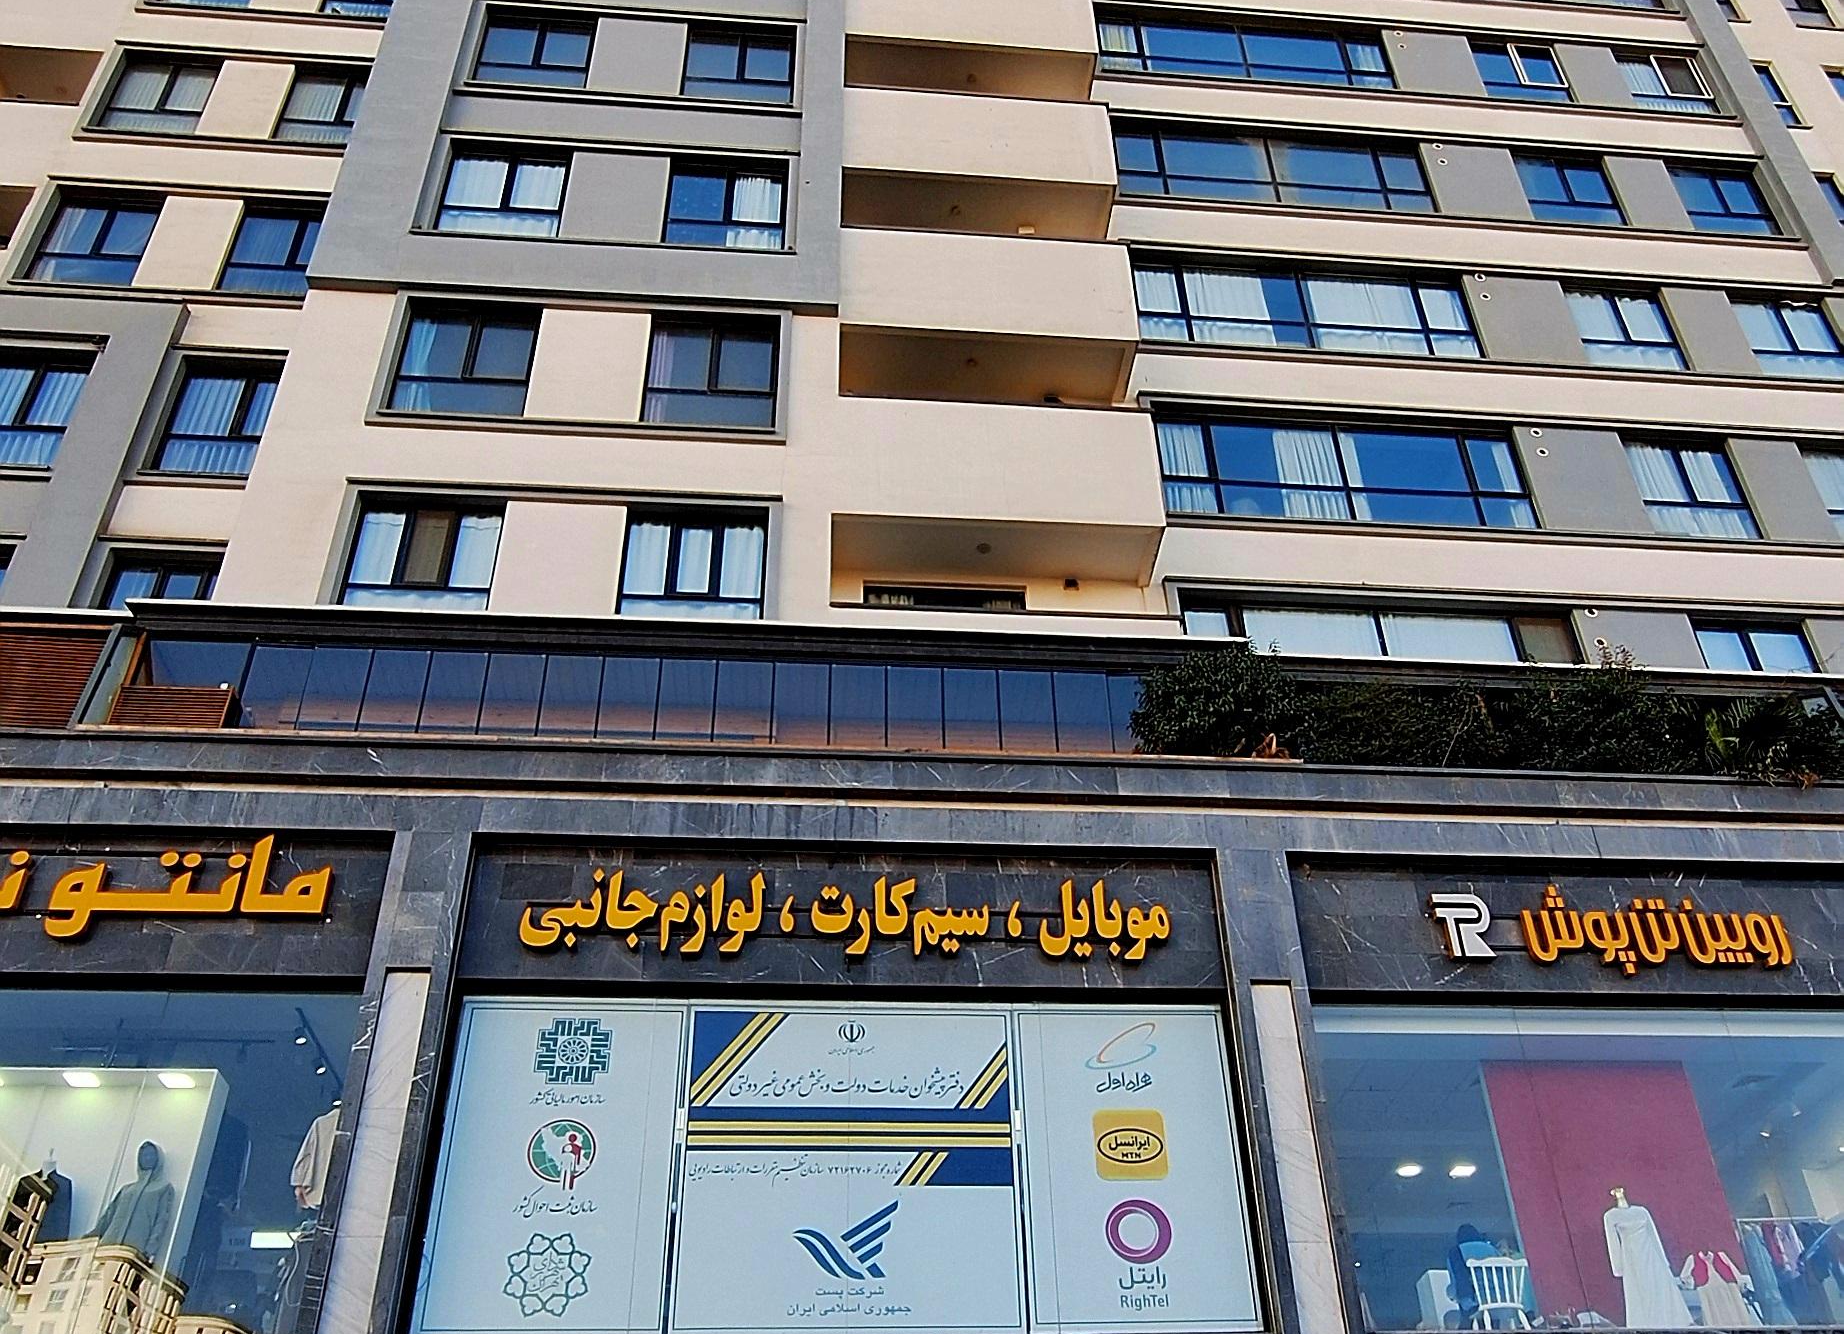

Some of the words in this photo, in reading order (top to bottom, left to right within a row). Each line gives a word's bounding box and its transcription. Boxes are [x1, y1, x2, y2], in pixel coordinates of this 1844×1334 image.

[44, 834, 332, 937] مانتو
[519, 867, 659, 948] جانبی
[660, 871, 766, 953] لوازم
[1040, 879, 1171, 961] موبایل
[773, 1075, 803, 1097] عمومی
[798, 1069, 826, 1097] بخش
[831, 1077, 867, 1093] دولت
[867, 1075, 909, 1093] خدمات
[909, 1067, 946, 1098] پیشخوان
[939, 1071, 964, 1098] دفتر
[1109, 1135, 1150, 1151] ایرانسل
[1121, 1151, 1142, 1159] MTN
[1119, 1266, 1167, 1290] رایتل
[815, 1287, 844, 1299] پست
[847, 1286, 885, 1298] شرکت
[786, 1303, 816, 1316] ایران
[819, 1303, 860, 1316] اسلامی
[863, 1304, 912, 1315] جمهوری
[1120, 1294, 1169, 1311] RighTel
